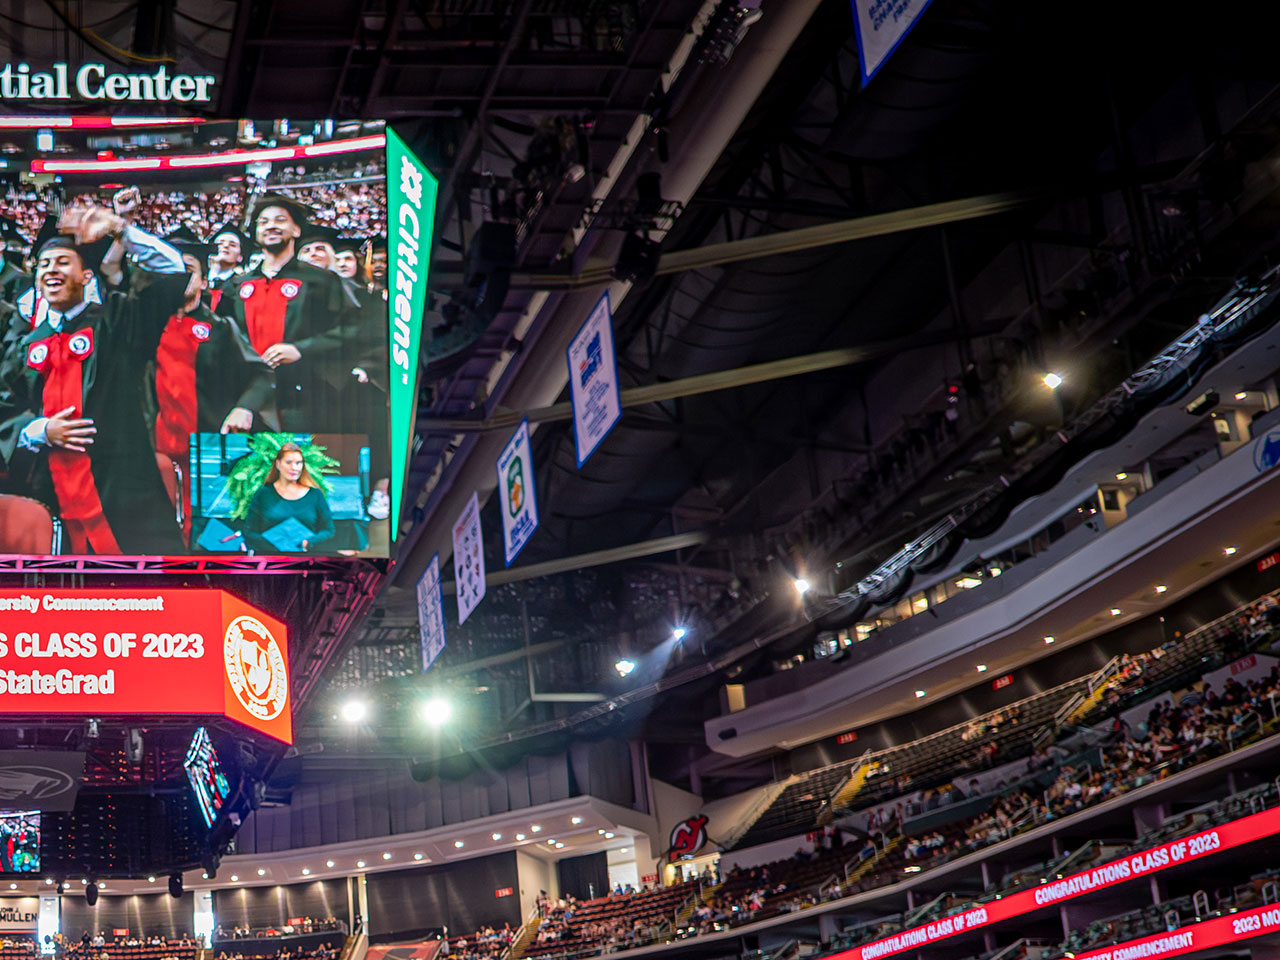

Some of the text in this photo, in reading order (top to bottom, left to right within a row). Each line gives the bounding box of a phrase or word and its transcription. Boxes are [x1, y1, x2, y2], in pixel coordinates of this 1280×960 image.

[77, 64, 215, 101] Center
[43, 595, 164, 613] Commencement
[14, 633, 98, 658] CLASS
[103, 633, 136, 658] OF
[142, 633, 205, 658] 2023
[1035, 832, 1219, 904] CONGRATULATIONS CLASS OF 2023
[862, 909, 987, 960] CONGRATULATIONS CLASS OF 2023
[1233, 915, 1260, 933] 2023
